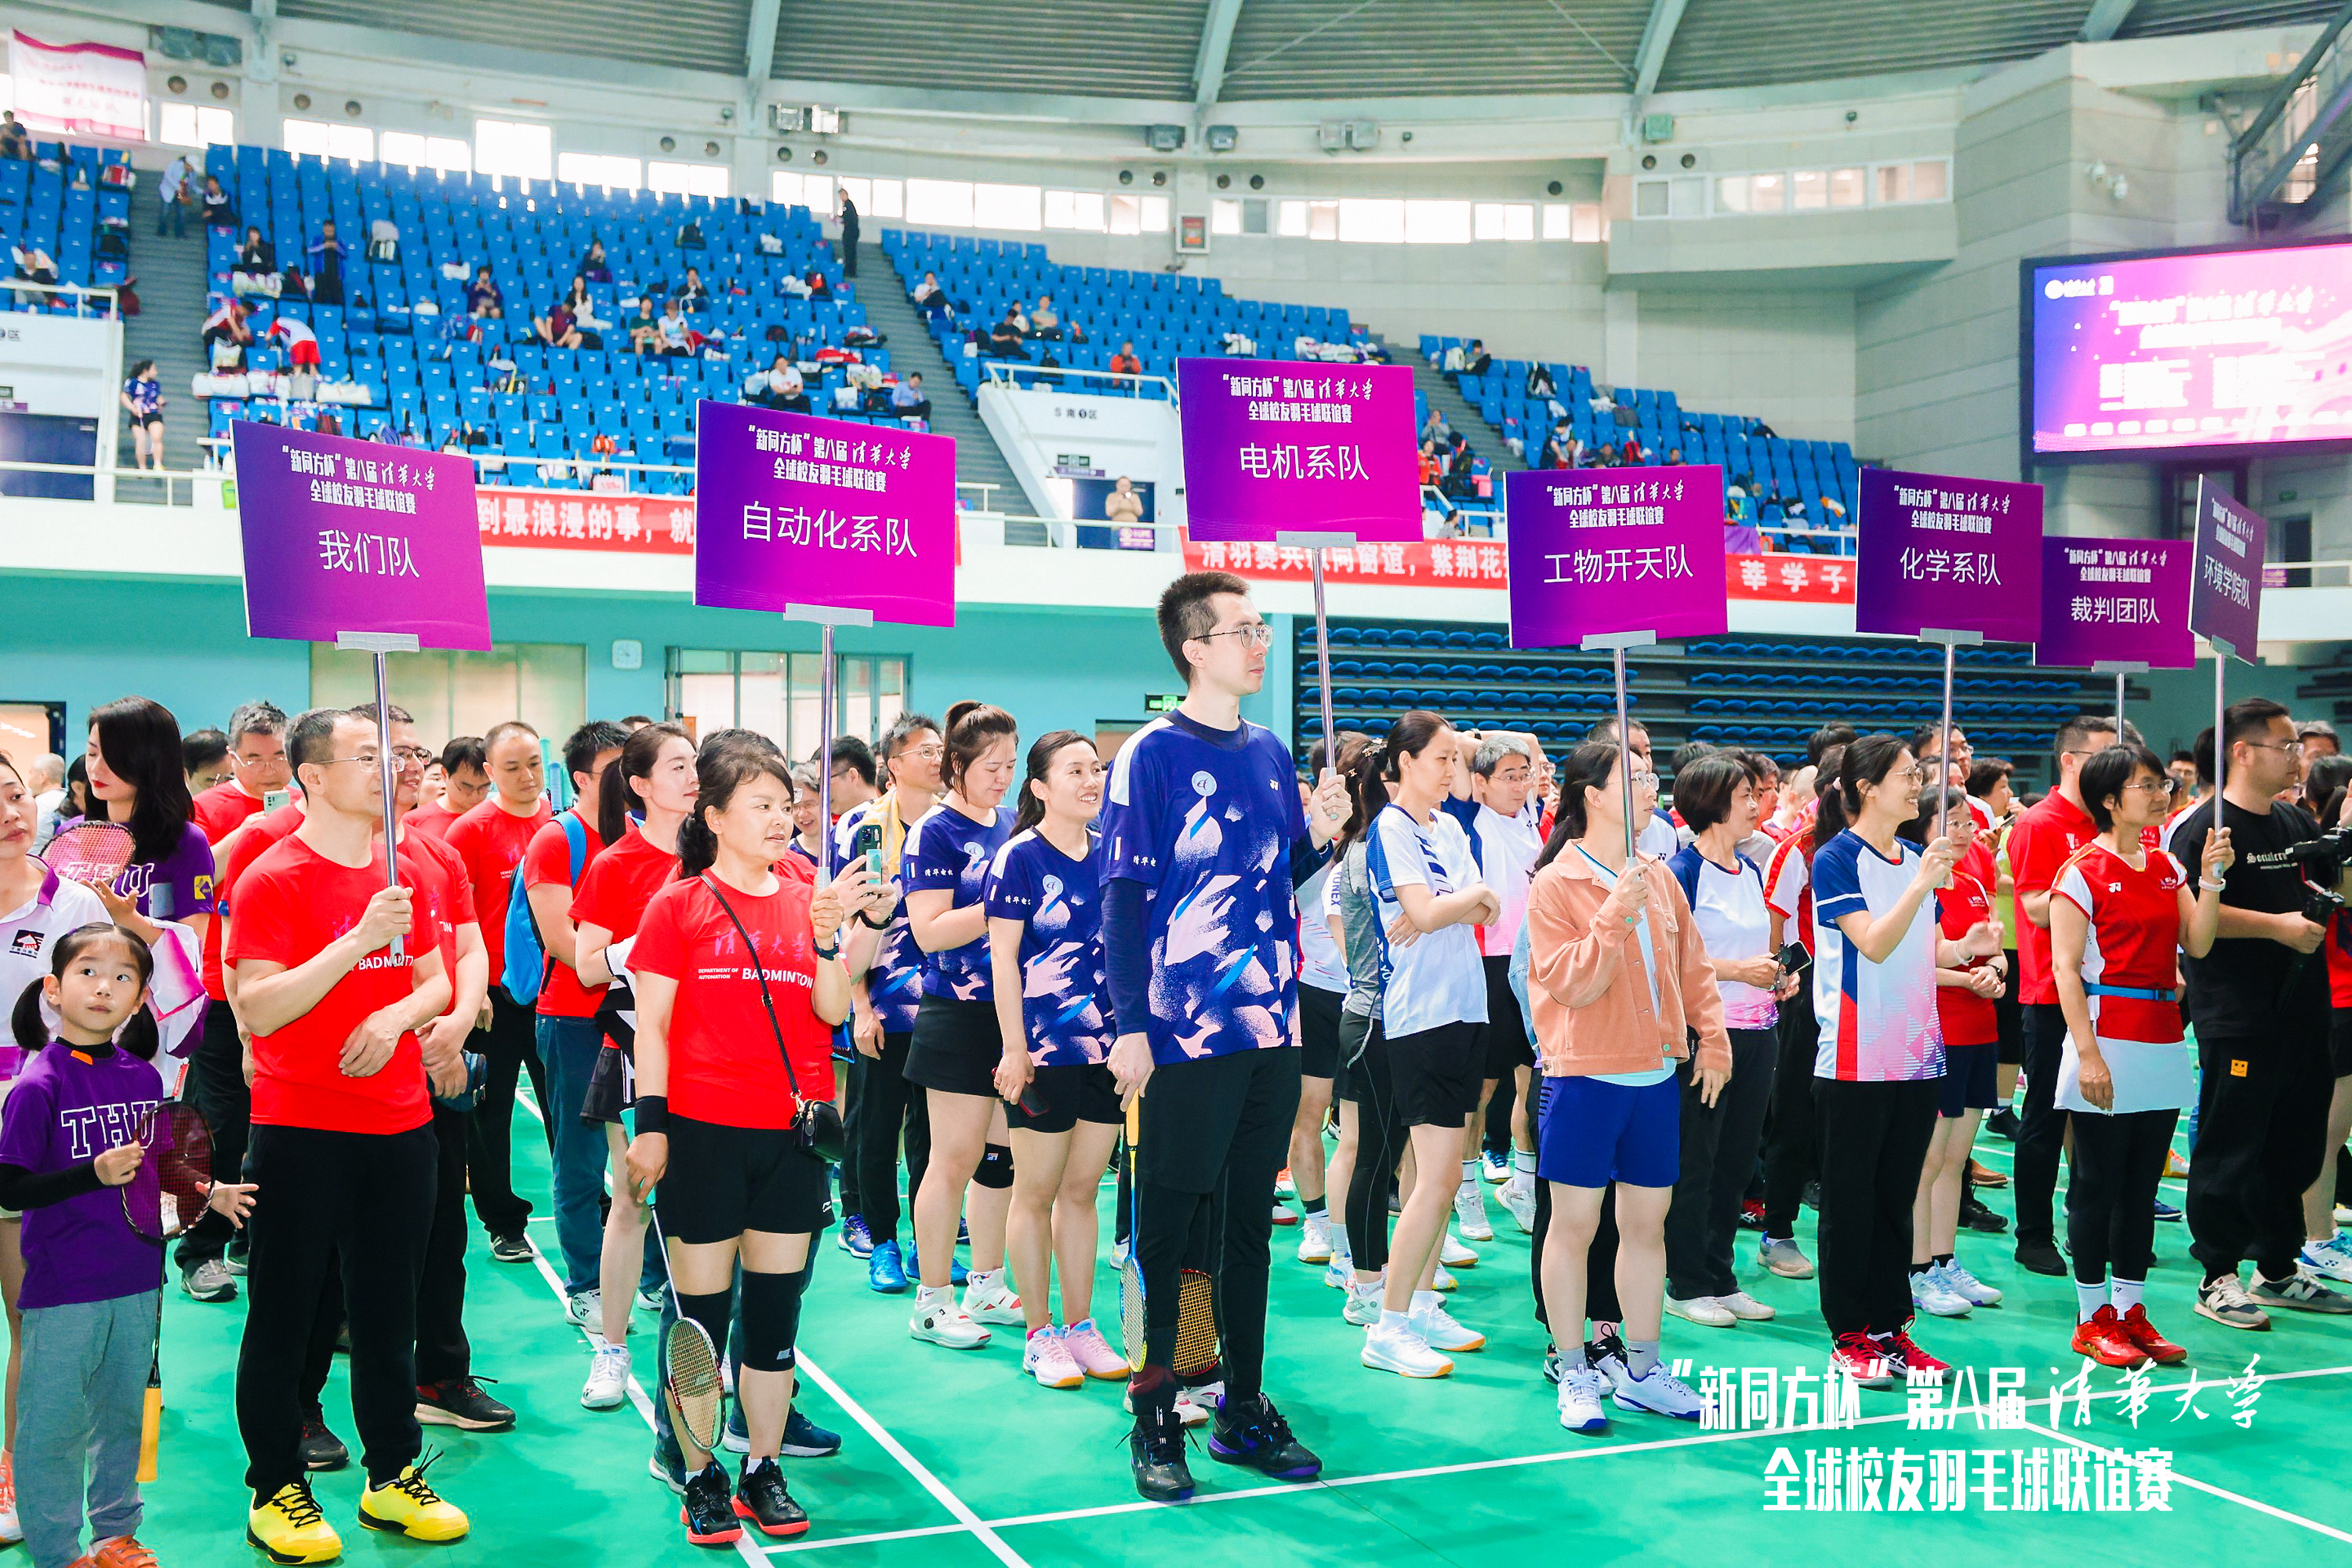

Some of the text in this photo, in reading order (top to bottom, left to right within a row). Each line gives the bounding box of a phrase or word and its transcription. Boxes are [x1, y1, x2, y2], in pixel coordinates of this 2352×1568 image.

[1249, 401, 1352, 423] 全球校友羽毛球联谊赛
[773, 457, 887, 492] 全球校友羽毛球联谊赛
[1240, 443, 1370, 480] 电机系队
[310, 479, 416, 514] 全球校友羽毛球联谊赛
[743, 501, 918, 558] 自动化系队
[1570, 506, 1664, 528] 全球校友羽毛球联谊赛
[318, 529, 420, 578] 我们队
[1544, 543, 1694, 584] 工物开天队
[1900, 546, 2002, 586] 化学系队
[2203, 555, 2251, 610] 环境学院队
[2071, 595, 2161, 624] 裁判团队
[742, 967, 813, 989] BADMINTON
[1380, 964, 1393, 983] YO
[61, 1100, 158, 1159] THU
